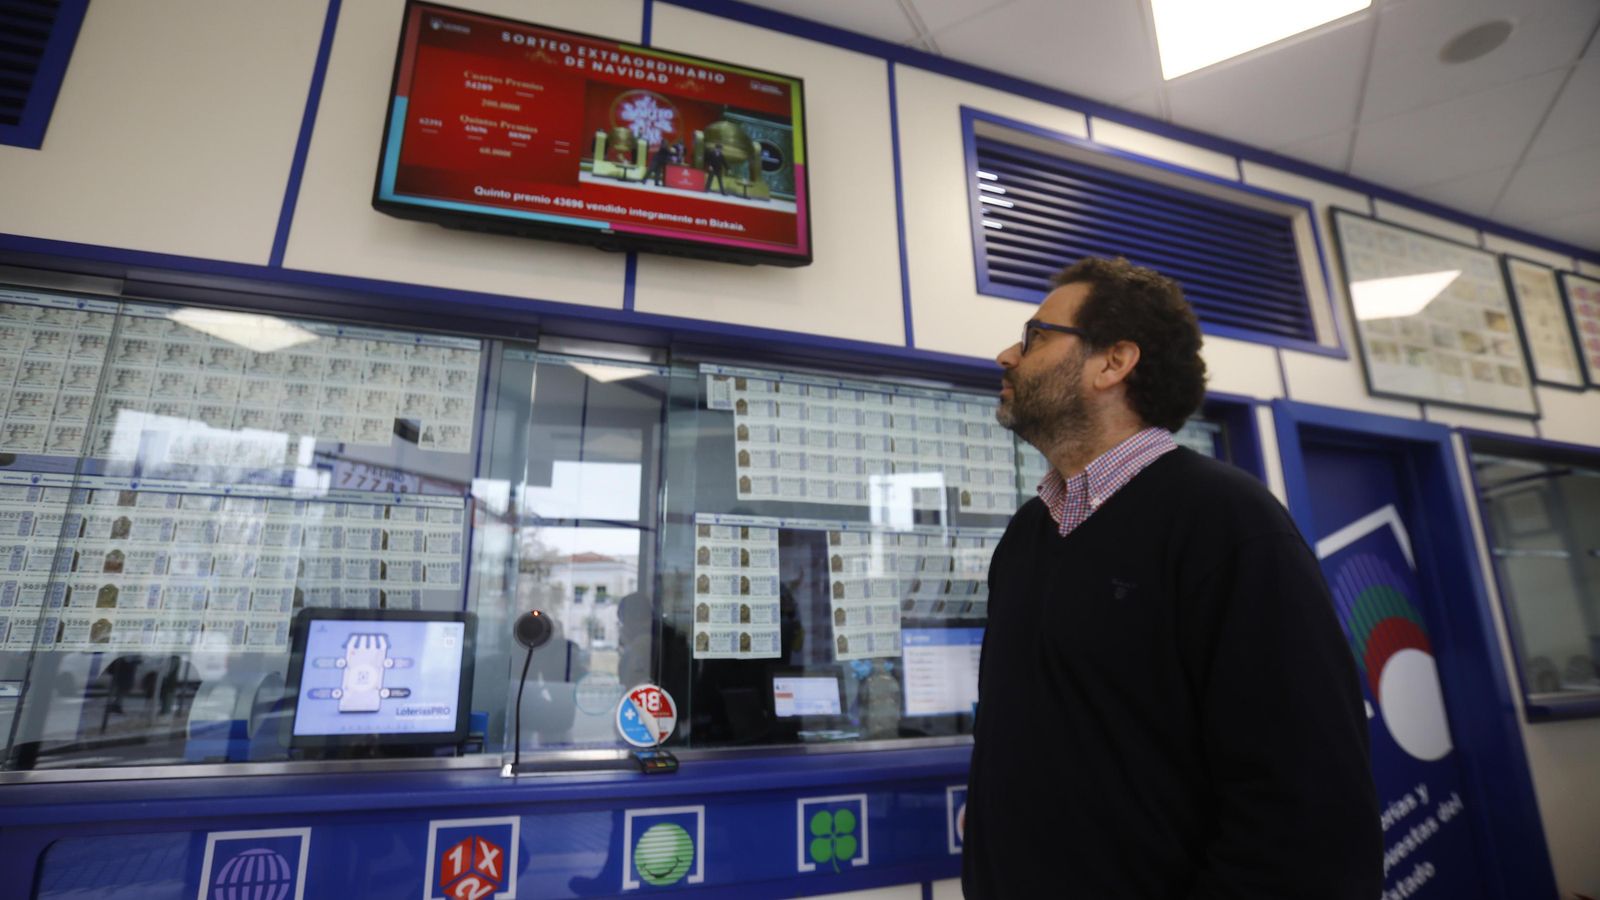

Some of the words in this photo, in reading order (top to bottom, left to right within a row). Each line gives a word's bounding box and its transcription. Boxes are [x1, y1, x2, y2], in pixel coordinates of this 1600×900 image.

[502, 31, 571, 54] SORTEO
[578, 46, 726, 84] EXTRAORDINARIO
[564, 56, 585, 68] DE
[592, 61, 669, 84] NAVIDAD
[474, 185, 511, 199] Quinto
[513, 191, 551, 205] premio
[552, 196, 584, 209] 43696
[586, 201, 627, 215] vendido
[695, 216, 708, 226] en
[1437, 791, 1465, 823] del
